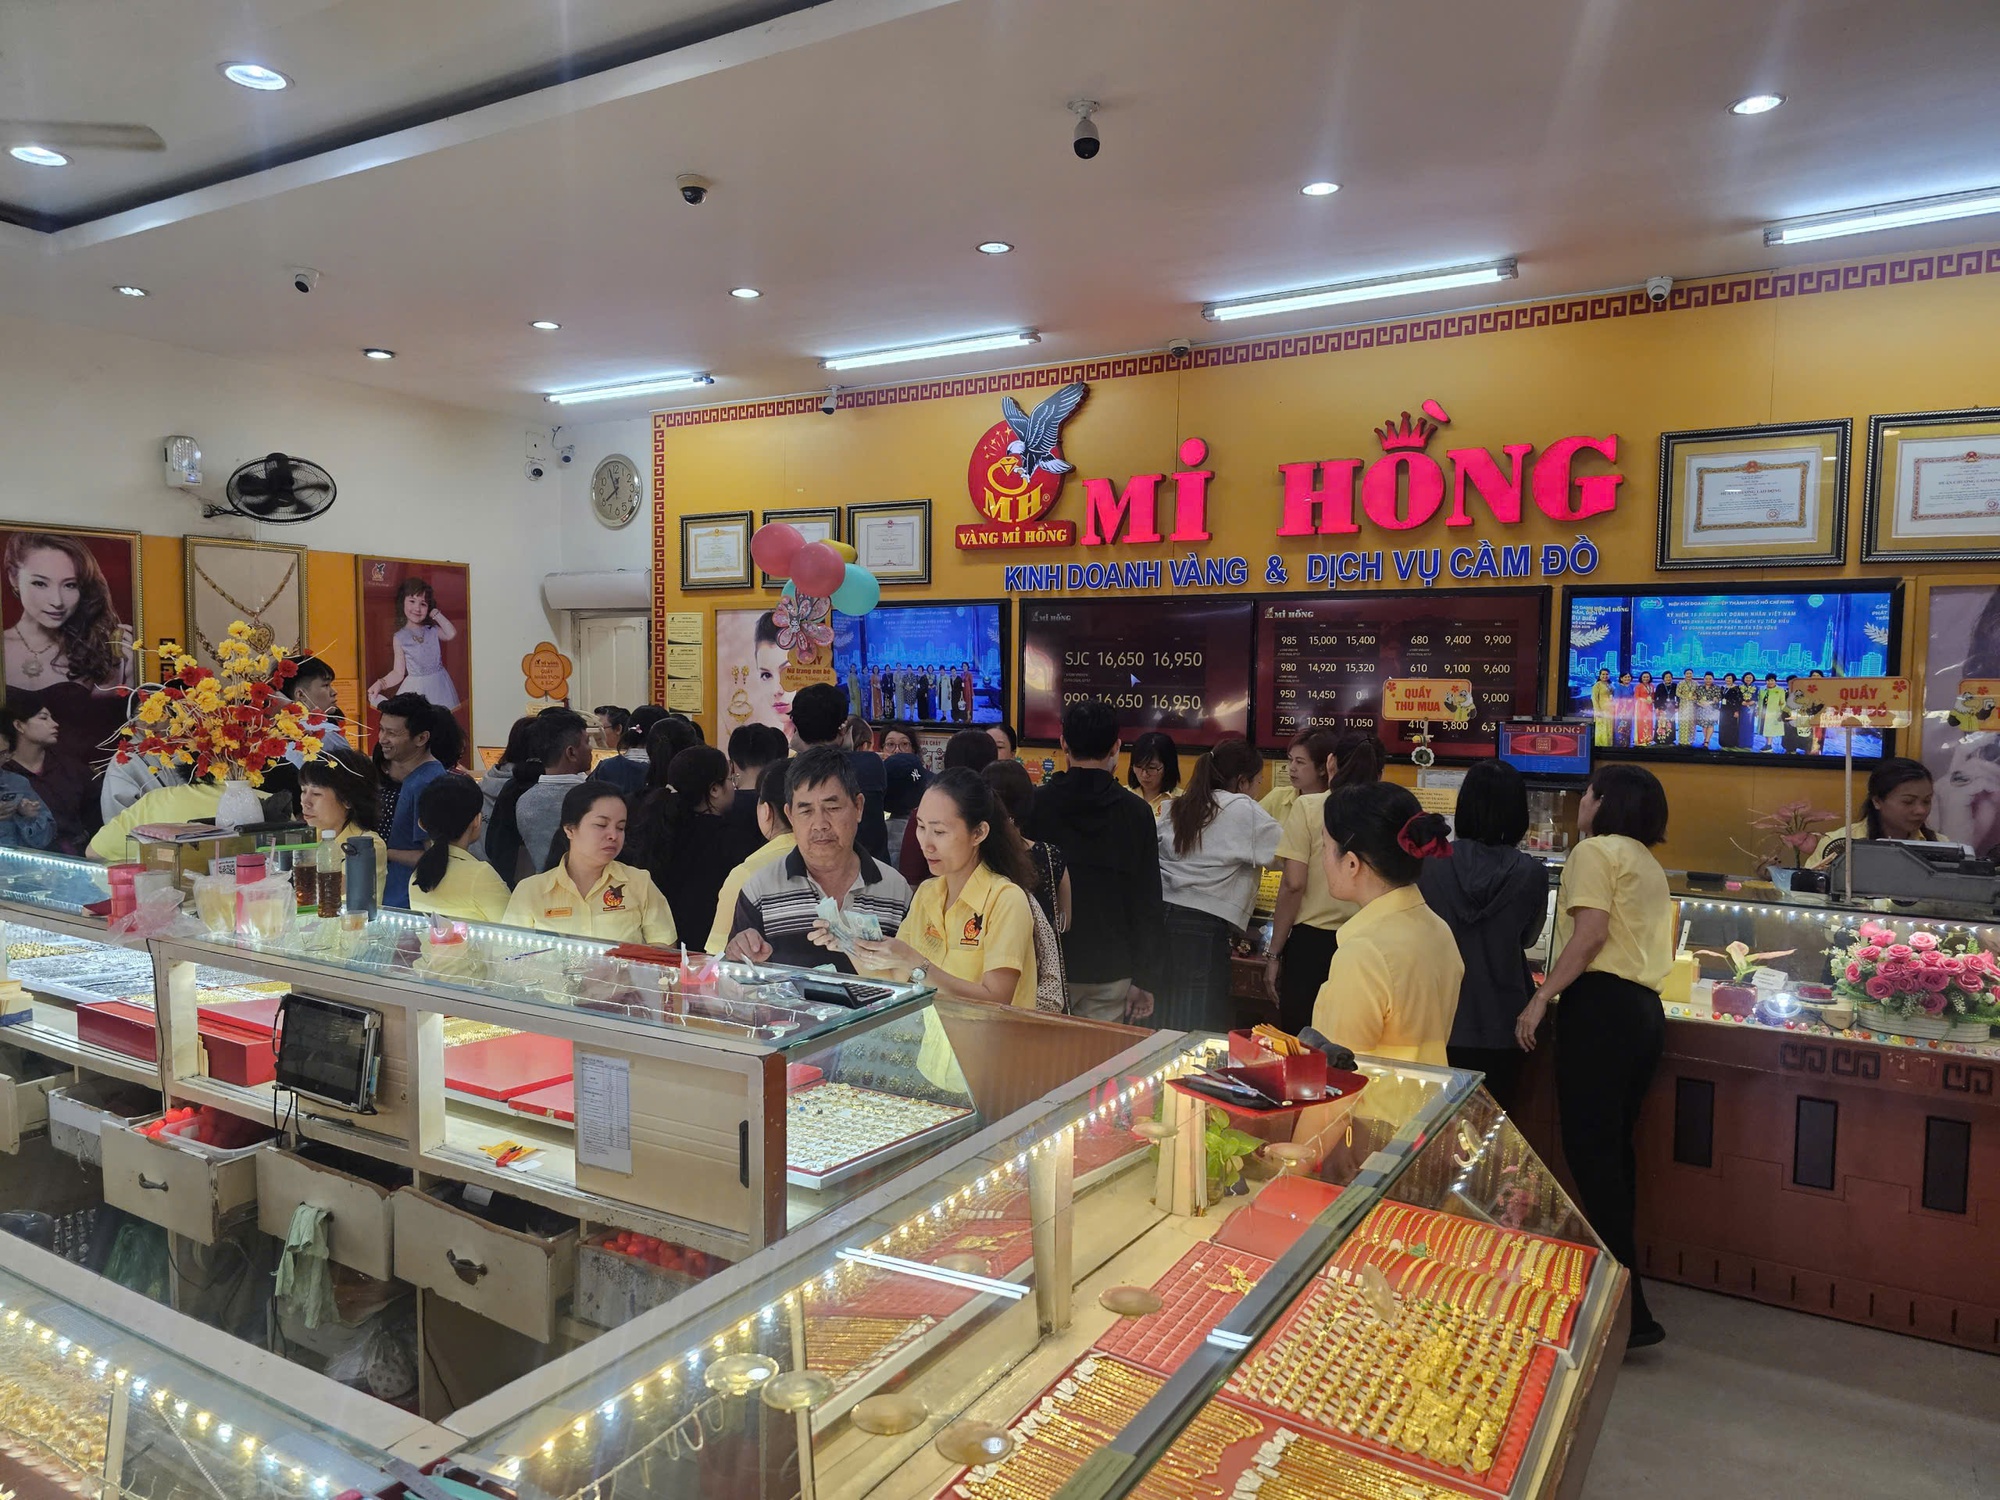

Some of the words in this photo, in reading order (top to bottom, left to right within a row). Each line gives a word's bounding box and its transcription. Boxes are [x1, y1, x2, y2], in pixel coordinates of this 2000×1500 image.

[613, 465, 619, 473] 12
[1276, 399, 1624, 536] HỒNG
[627, 474, 631, 482] 2
[622, 502, 627, 511] 5
[983, 483, 1043, 523] MH
[608, 504, 612, 513] 7
[959, 530, 999, 545] VÀNG
[1025, 523, 1067, 542] HỒNG
[1004, 564, 1061, 591] KINH
[1067, 560, 1161, 590] DOANH
[1168, 553, 1247, 588] VÀNG
[1264, 554, 1288, 584] &
[1306, 551, 1383, 589] DỊCH
[1393, 548, 1440, 587] VỤ
[1449, 540, 1531, 578] CẦM
[1540, 534, 1599, 576] ĐỒ
[1281, 636, 1296, 644] 985
[1309, 636, 1337, 645] 15,000
[1347, 636, 1376, 645] 15,400
[1411, 636, 1428, 644] 680
[1445, 636, 1471, 646] 9,400
[1484, 635, 1511, 646] 9,900
[1065, 652, 1090, 666] SJC
[1098, 652, 1144, 668] 16,650
[1152, 652, 1202, 669] 16,950
[1280, 663, 1296, 671] 980
[1308, 663, 1336, 673] 14,920
[1345, 664, 1375, 673] 15,320
[1410, 664, 1427, 672] 610
[1444, 664, 1470, 674] 9,100
[1483, 664, 1510, 674] 9,600
[1280, 690, 1296, 698] 950
[1307, 690, 1336, 700] 14,450
[1482, 693, 1510, 703] 9,000
[1151, 695, 1201, 712] 16,950
[1395, 701, 1414, 712] THU
[1418, 701, 1440, 712] MUA
[1280, 716, 1295, 725] 750
[1306, 717, 1335, 726] 10,550
[1344, 718, 1374, 728] 11,050
[1442, 721, 1468, 731] 5,800
